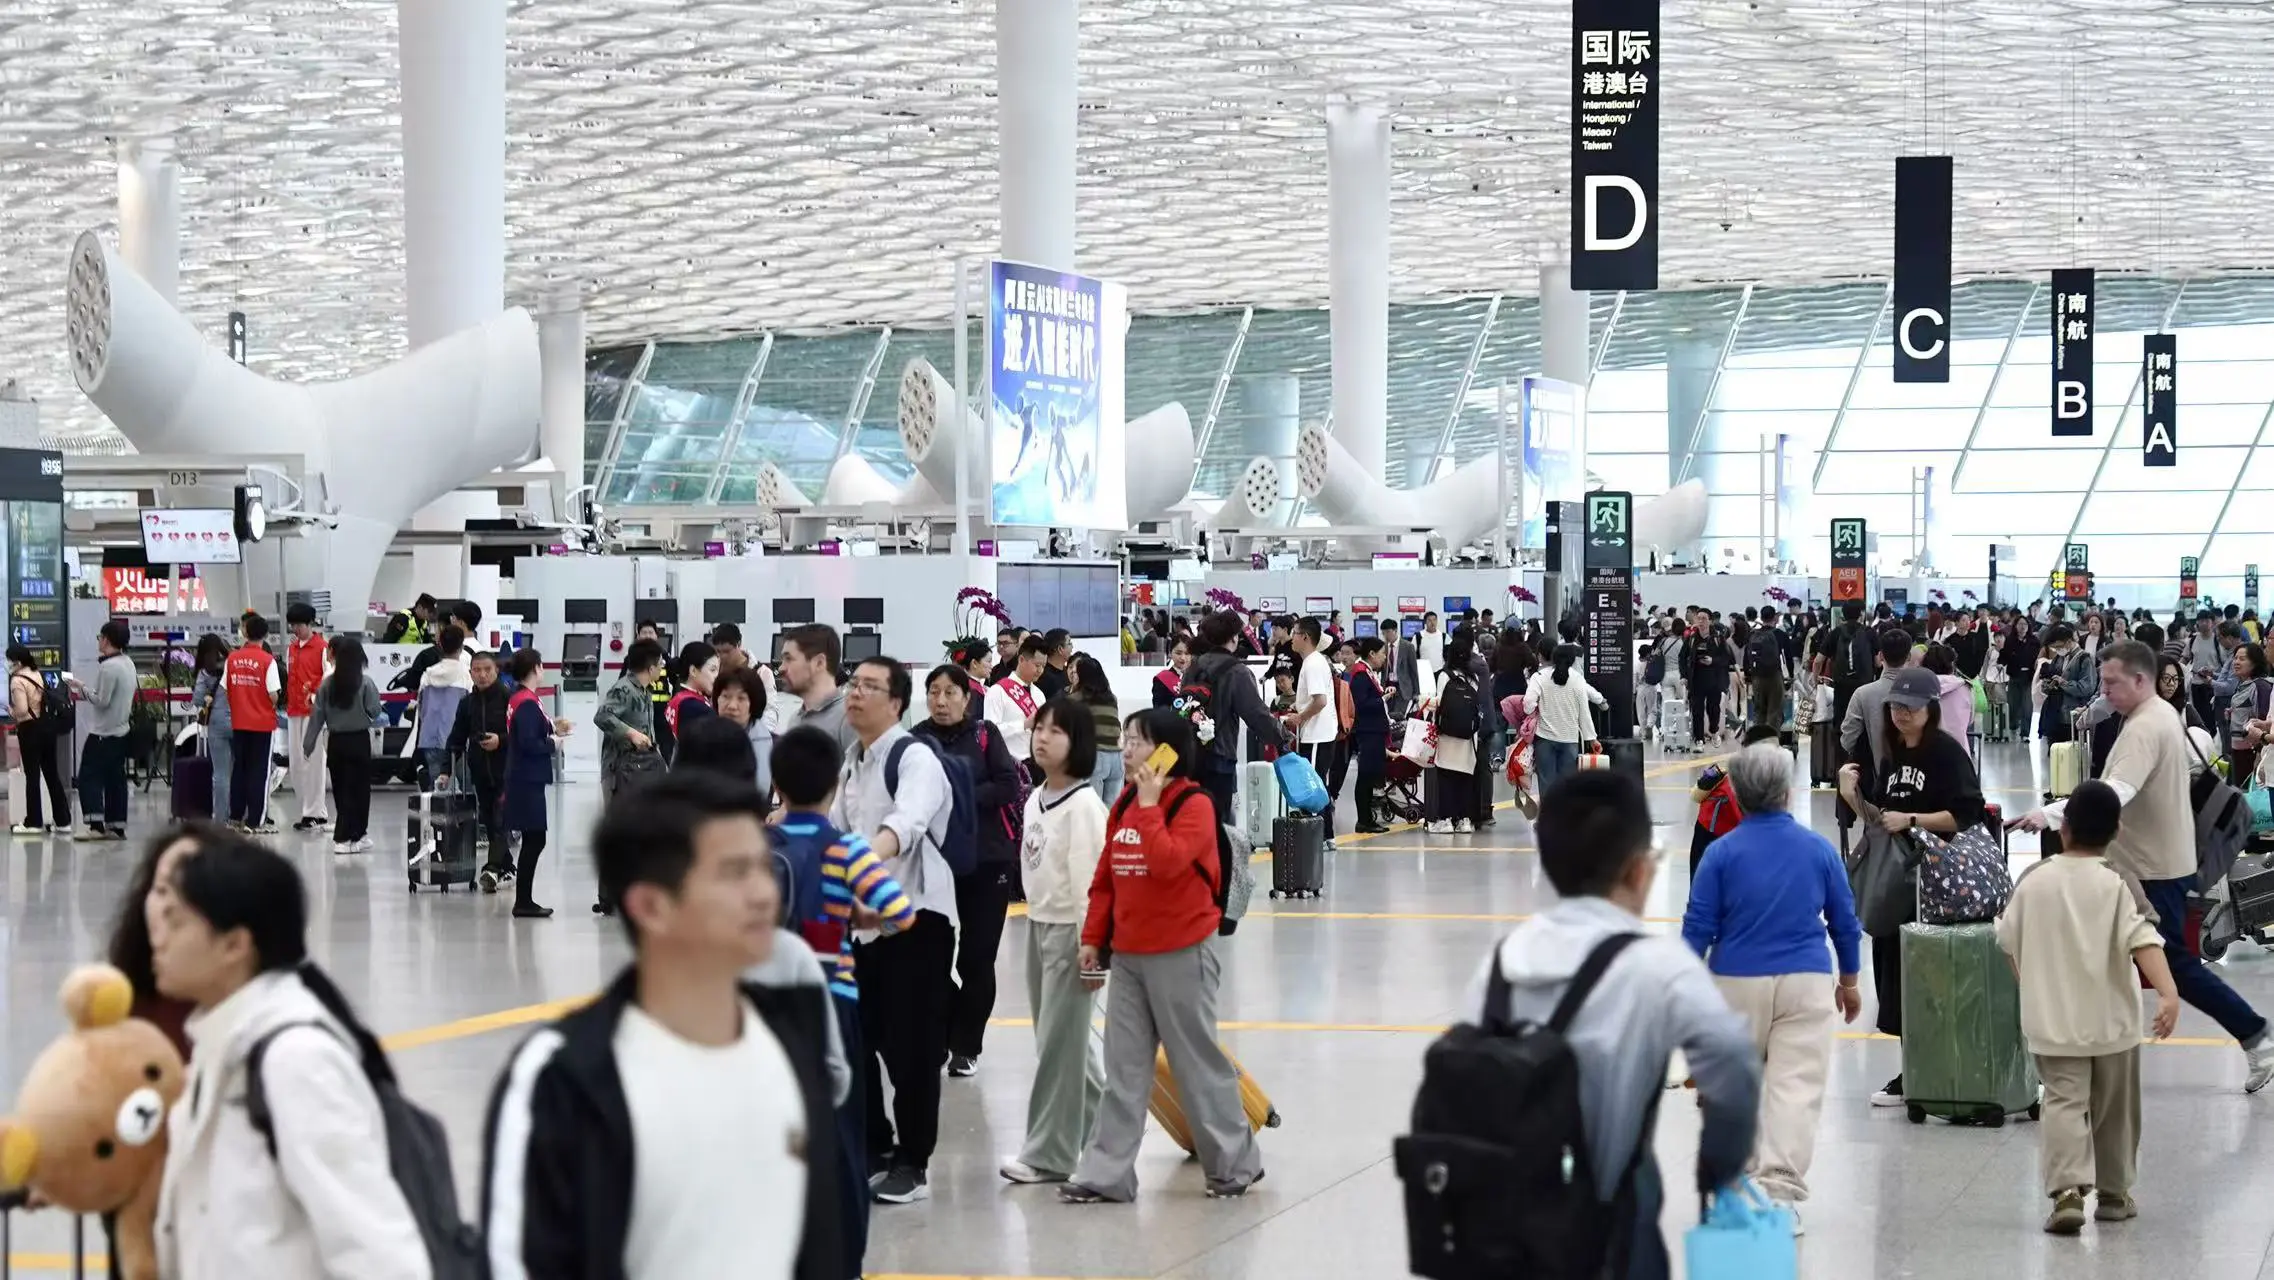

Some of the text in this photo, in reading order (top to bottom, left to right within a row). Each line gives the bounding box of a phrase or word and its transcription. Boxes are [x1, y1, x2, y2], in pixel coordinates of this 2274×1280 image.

[1582, 30, 1651, 65] 国际
[1583, 71, 1648, 94] 港澳台
[1583, 100, 1634, 109] International
[1583, 114, 1626, 124] Hongkong
[1582, 127, 1611, 136] Macao
[1582, 141, 1612, 150] Taiwan
[1585, 175, 1647, 250] D
[2067, 293, 2087, 340] 南航
[1900, 308, 1944, 359] C
[2155, 353, 2172, 391] 南航
[2058, 381, 2087, 418] B
[2145, 422, 2174, 453] A
[170, 472, 198, 485] D13
[1839, 568, 1857, 577] AED
[1599, 593, 1610, 608] E
